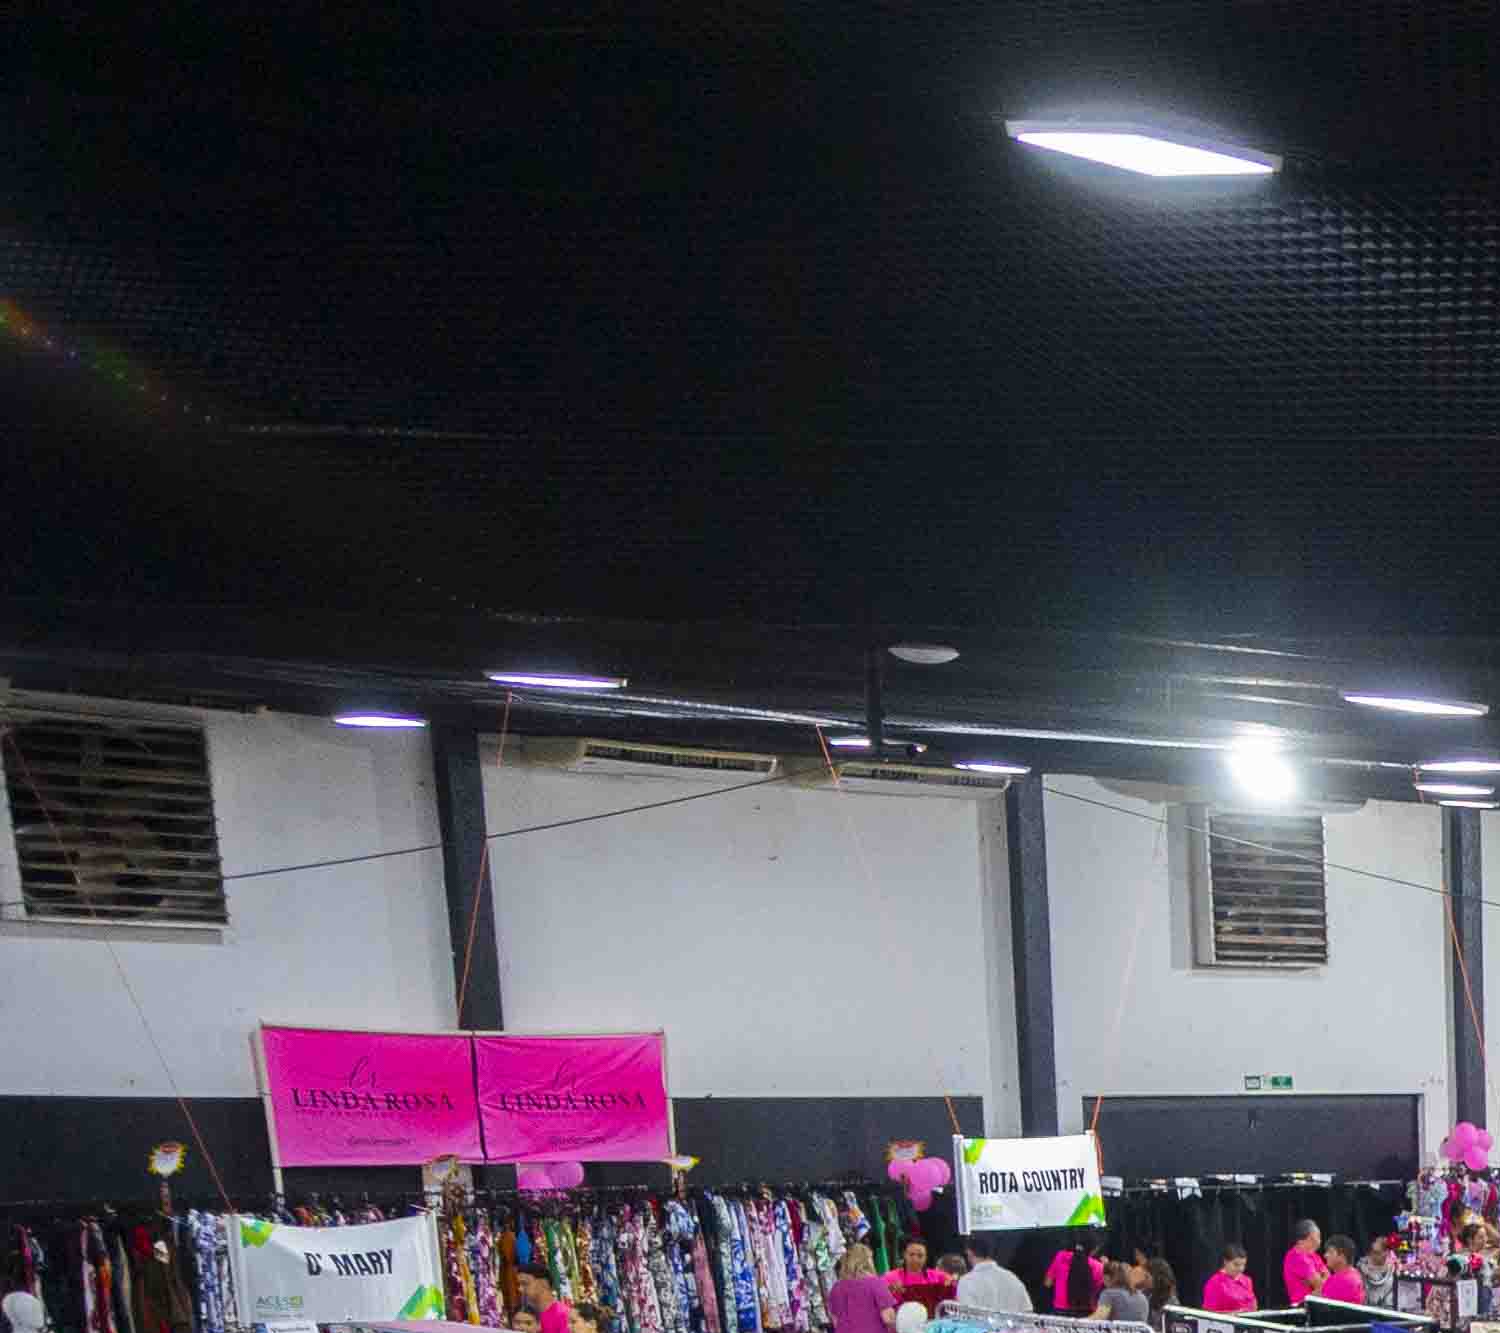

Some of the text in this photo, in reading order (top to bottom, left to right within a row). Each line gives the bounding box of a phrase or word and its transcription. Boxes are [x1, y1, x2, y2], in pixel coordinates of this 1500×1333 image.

[291, 1087, 454, 1111] LINDA ROSA
[500, 1091, 647, 1112] LINDA ROSA
[979, 1167, 1085, 1195] ROTA COUNTRY
[328, 1249, 393, 1276] MARY
